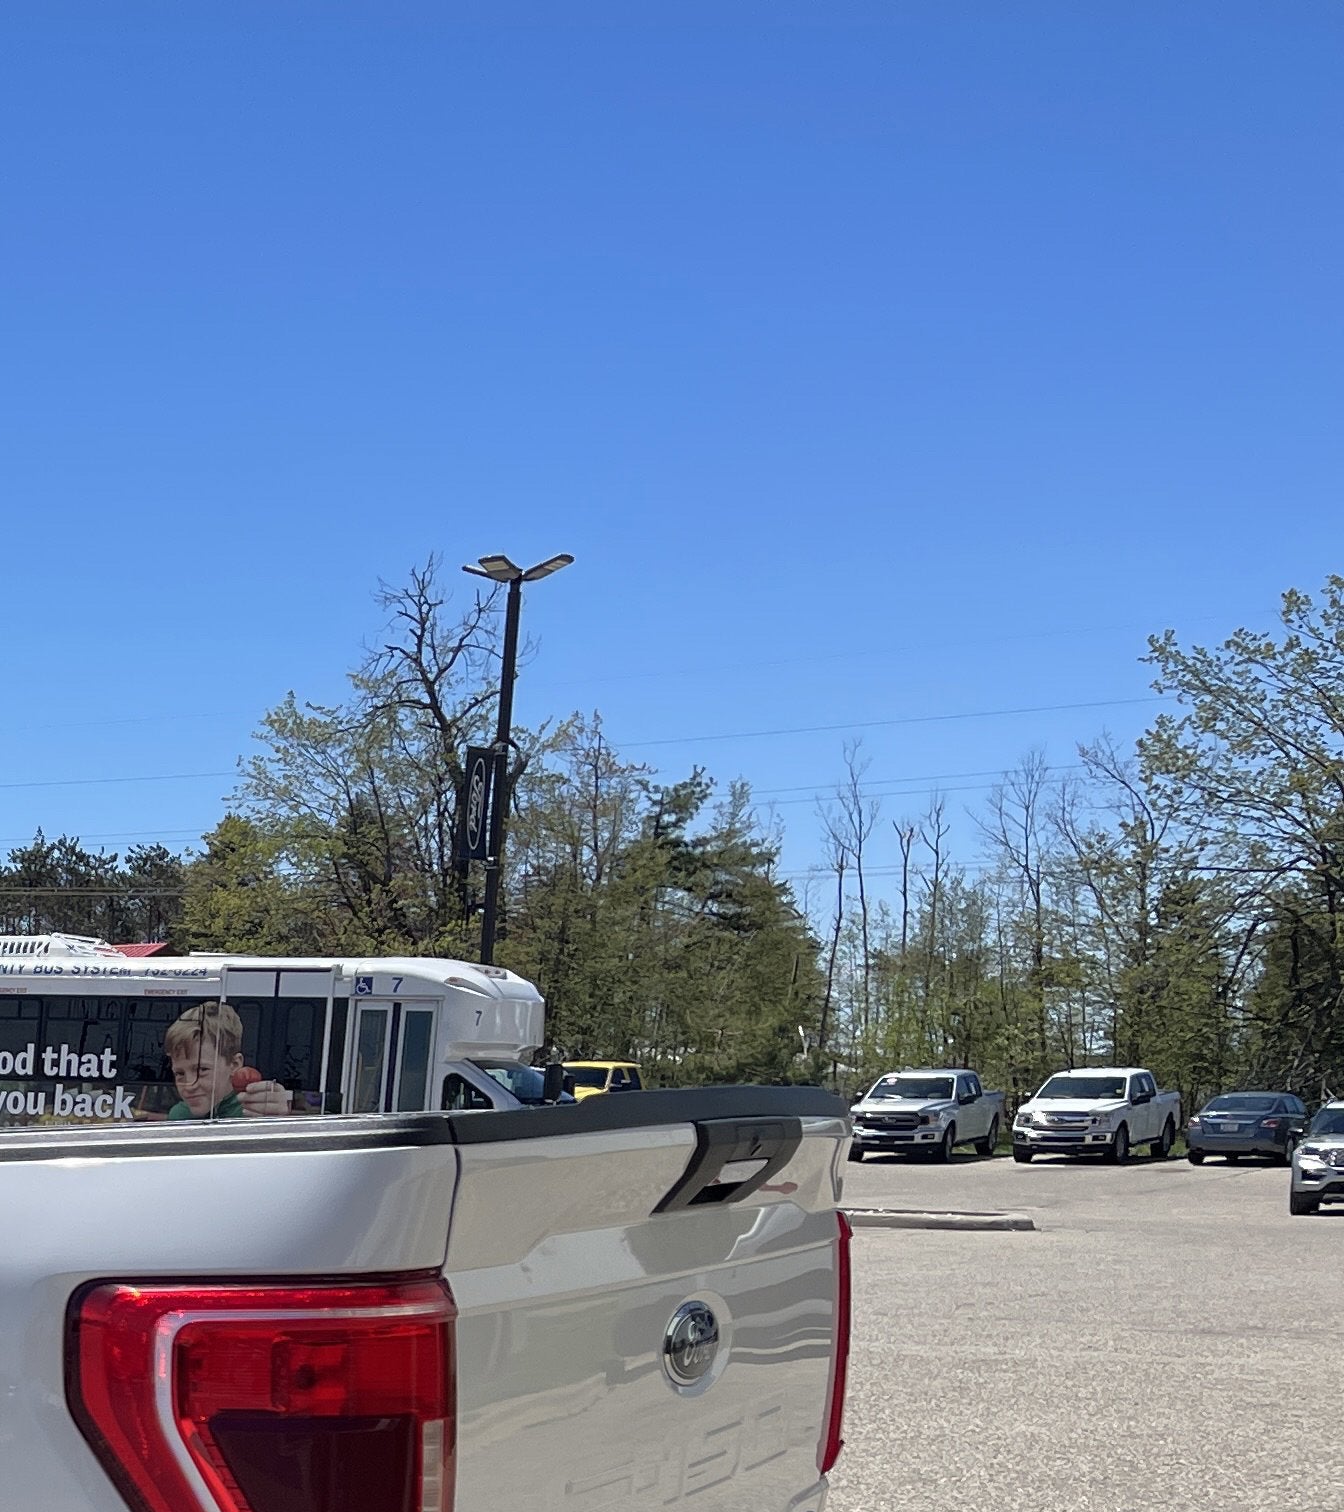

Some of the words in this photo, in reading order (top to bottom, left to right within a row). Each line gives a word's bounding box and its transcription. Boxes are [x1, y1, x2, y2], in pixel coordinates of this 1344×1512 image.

[391, 976, 404, 993] 7
[474, 1010, 483, 1027] 7
[42, 1044, 118, 1079] that
[53, 1083, 136, 1119] back
